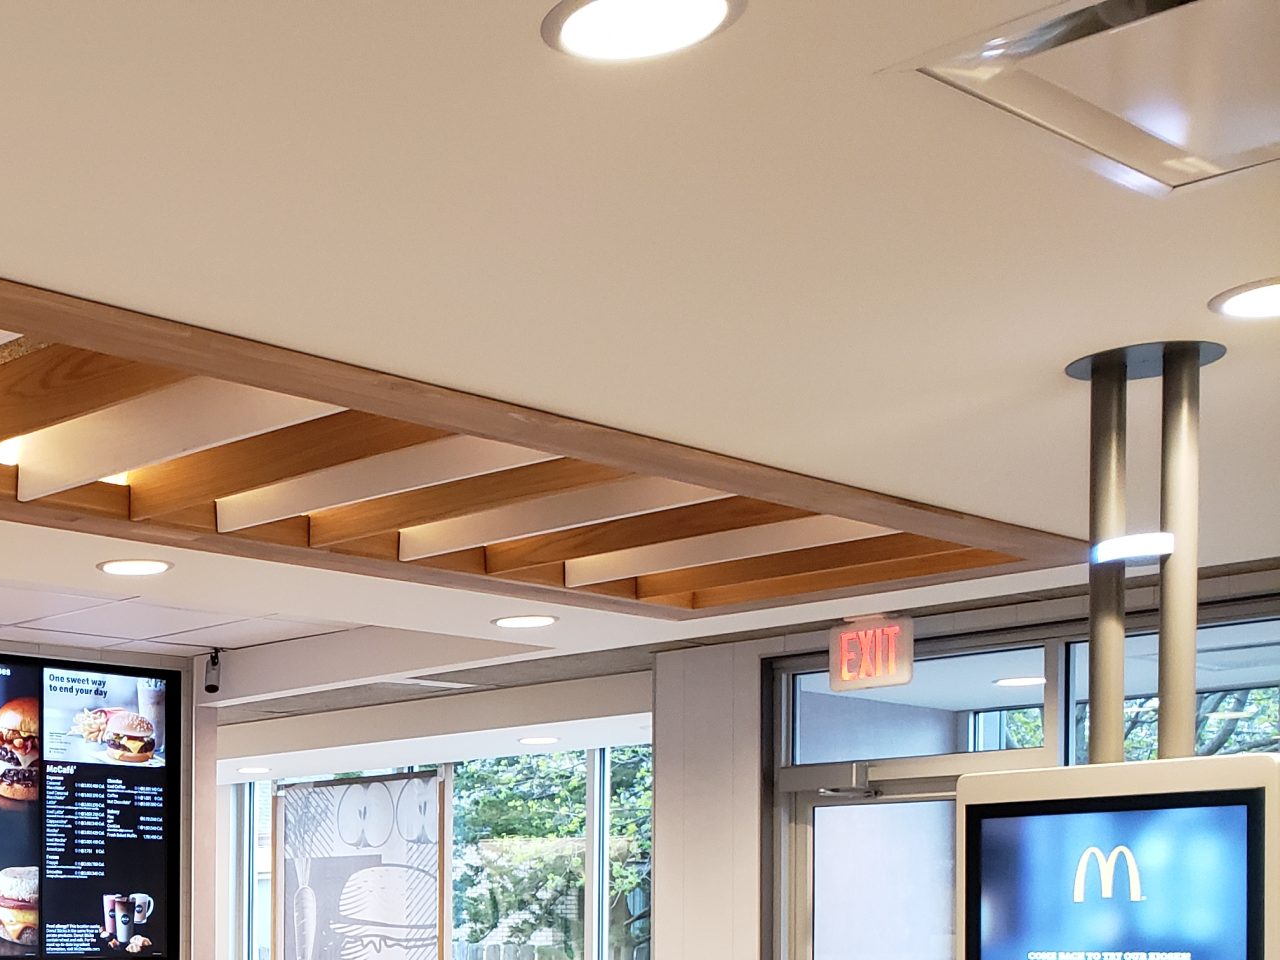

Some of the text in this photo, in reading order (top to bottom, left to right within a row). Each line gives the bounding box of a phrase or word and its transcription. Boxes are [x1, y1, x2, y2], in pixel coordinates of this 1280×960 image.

[840, 626, 900, 681] EXIT
[49, 674, 106, 688] One sweet way
[75, 688, 92, 696] your
[94, 688, 108, 698] day
[1028, 952, 1057, 960] COME
[1058, 952, 1085, 960] BACK
[1086, 952, 1101, 960] TO
[1102, 952, 1123, 960] TRY
[1124, 952, 1147, 960] OUR
